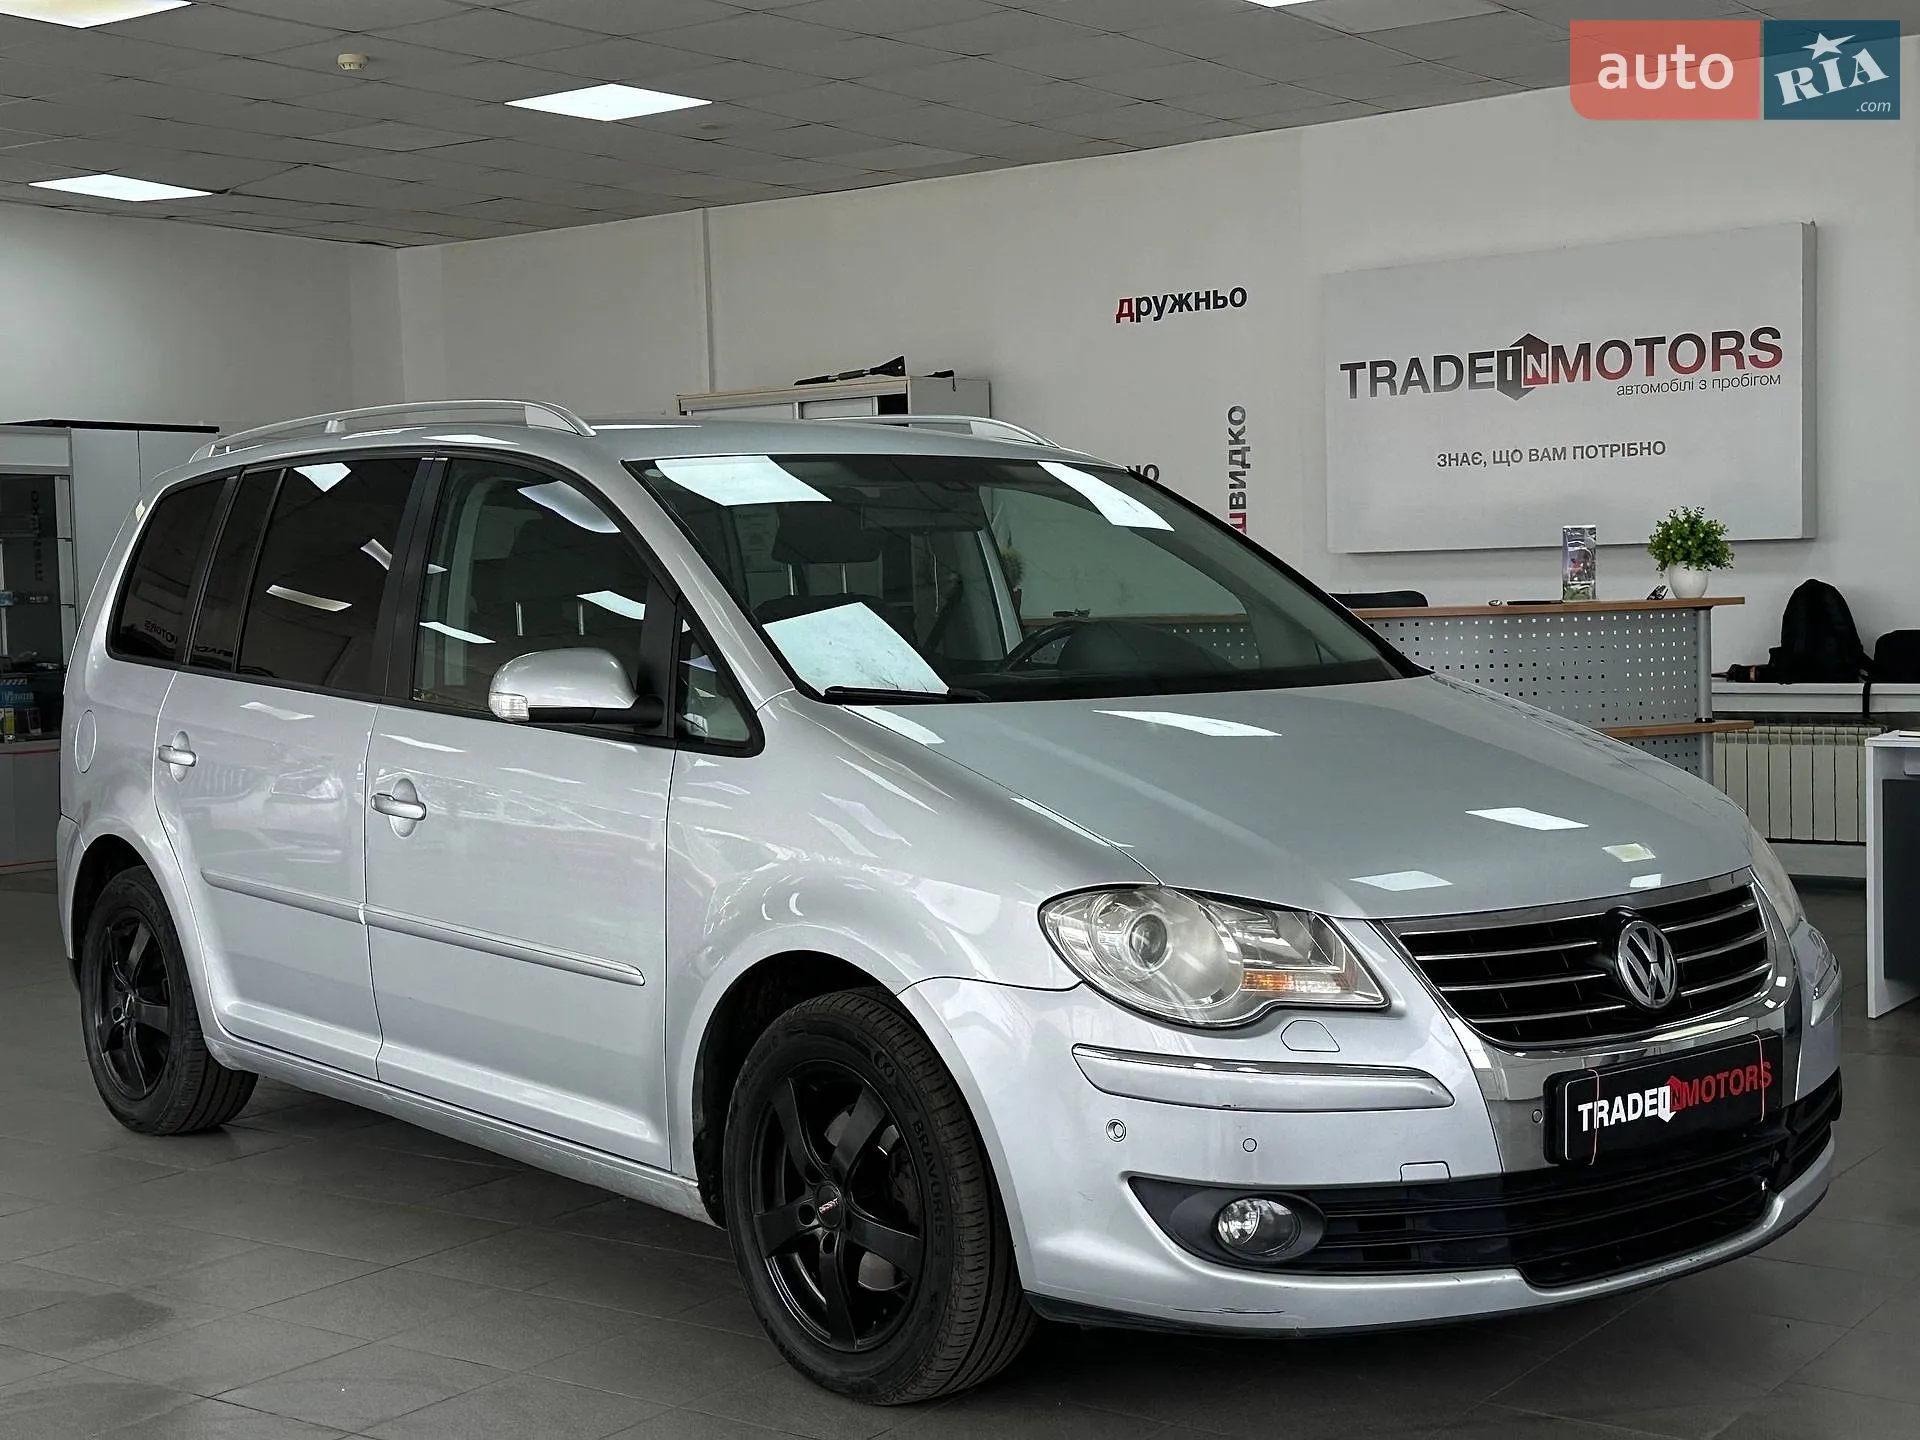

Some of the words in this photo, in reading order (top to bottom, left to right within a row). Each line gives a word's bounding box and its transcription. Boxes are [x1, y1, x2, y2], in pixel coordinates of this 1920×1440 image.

[1115, 286, 1248, 324] дружньо
[1616, 377, 1694, 397] автомобілі
[1699, 380, 1707, 391] з
[1712, 373, 1781, 392] пробігом
[1436, 451, 1487, 468] ЗНАЄ,
[1492, 449, 1523, 467] ЩО
[1528, 446, 1567, 463] ВАМ
[1573, 441, 1666, 460] ПОТРІБНО
